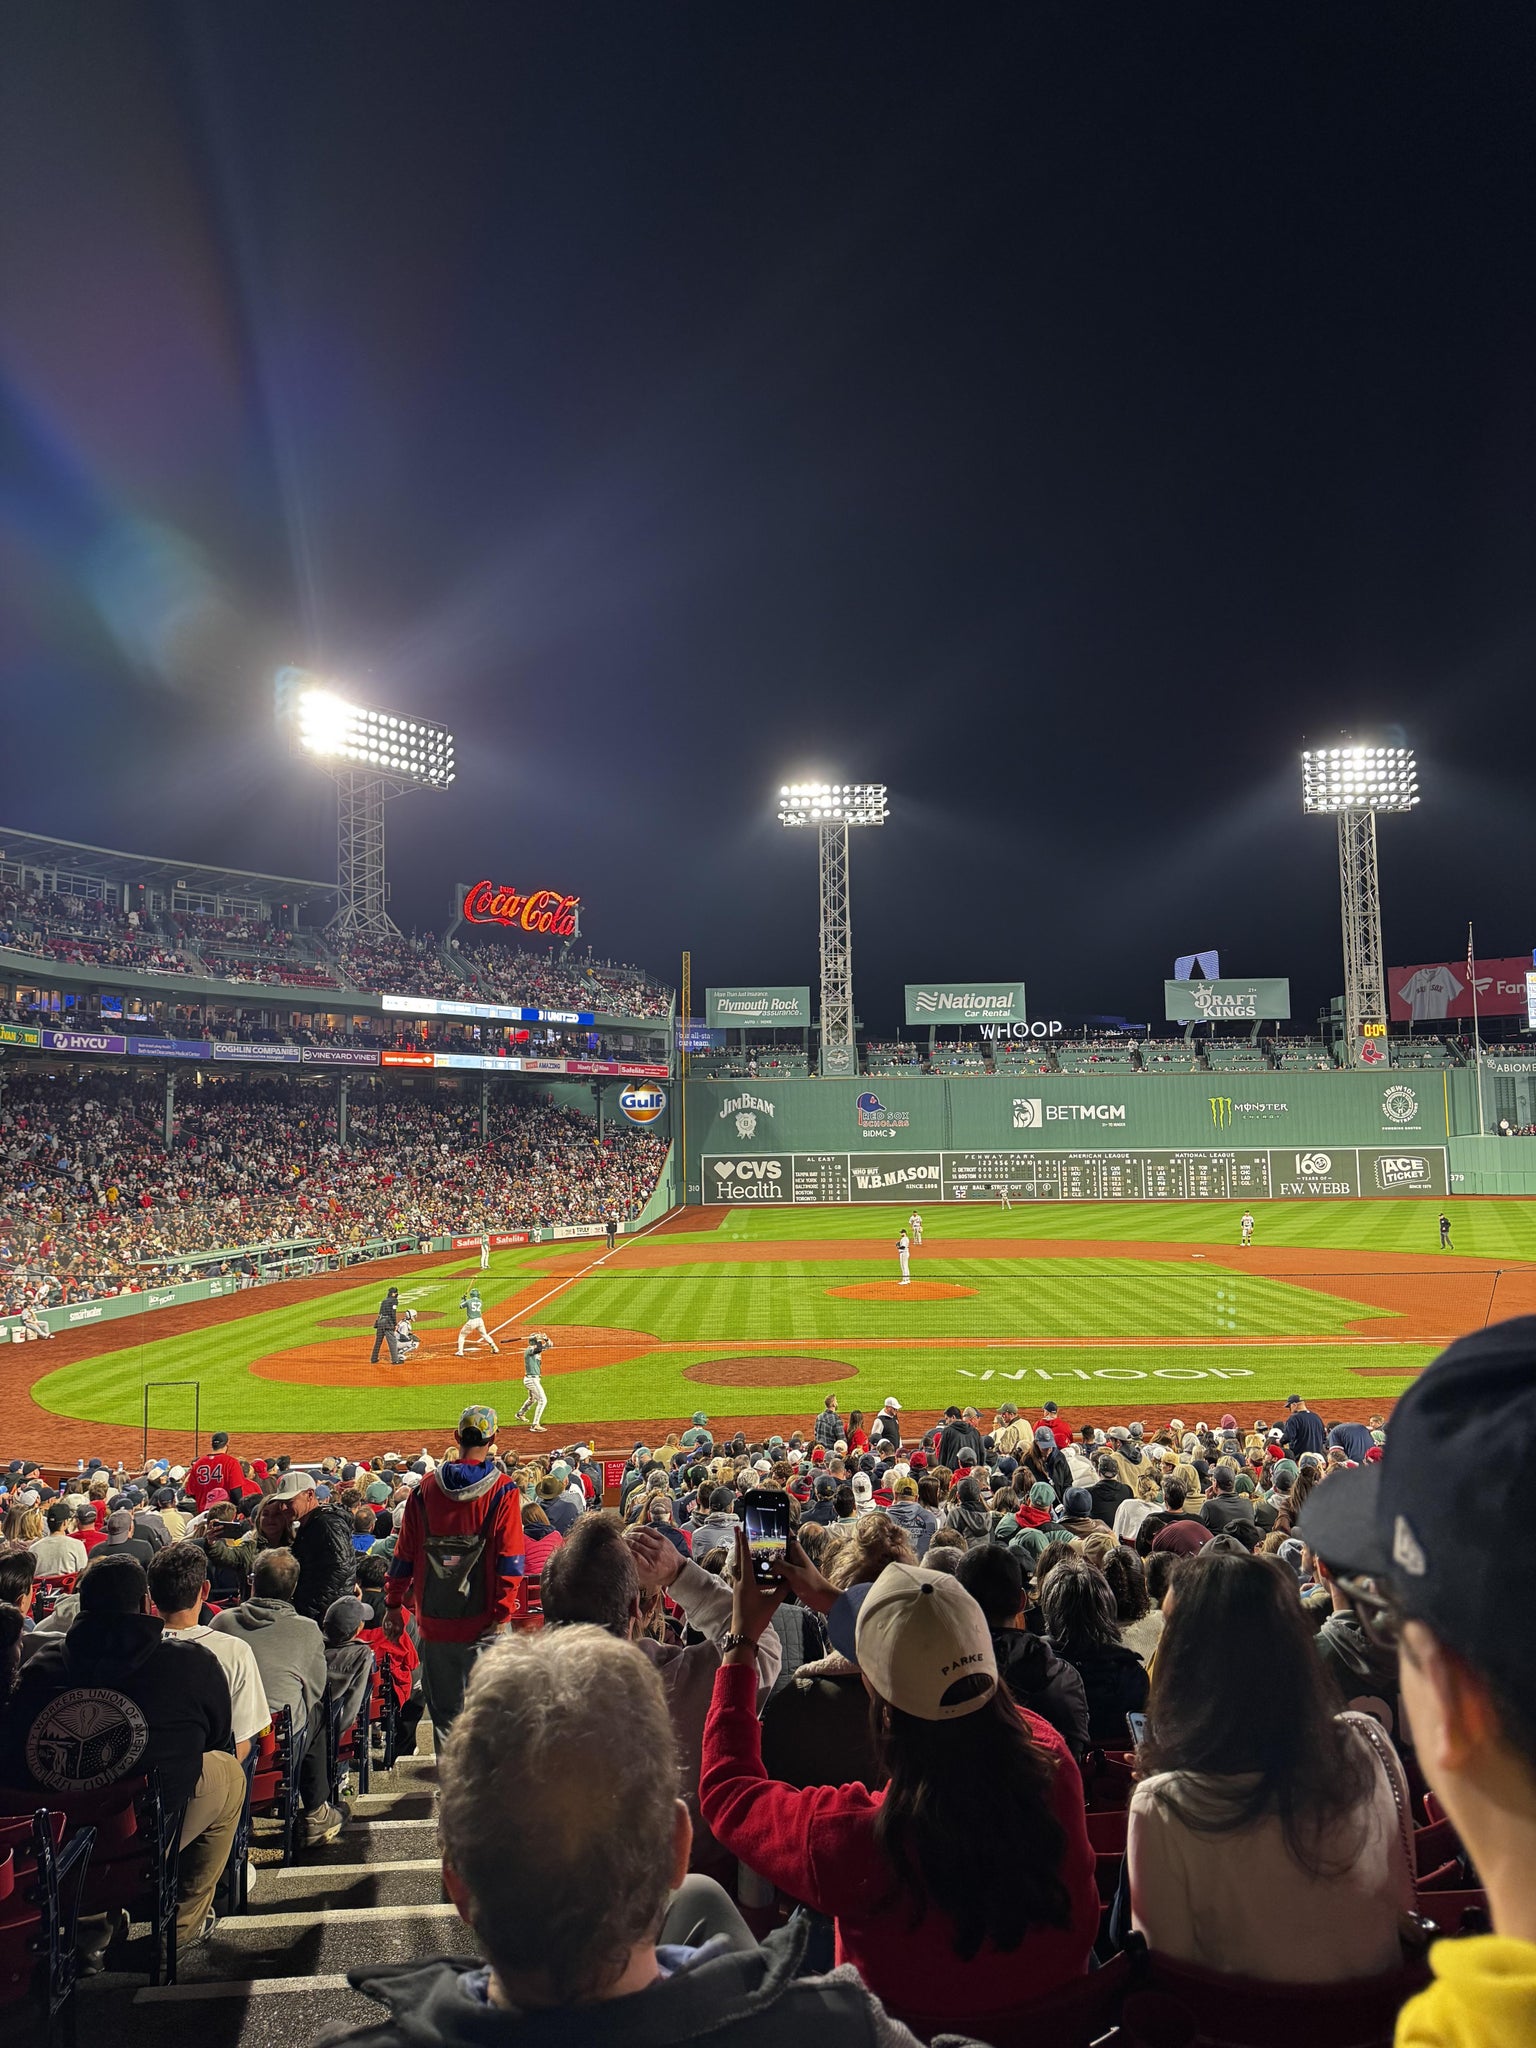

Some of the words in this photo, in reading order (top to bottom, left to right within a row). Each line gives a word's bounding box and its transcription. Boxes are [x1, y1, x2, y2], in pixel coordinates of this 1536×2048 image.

[464, 880, 580, 936] Coca-Cola
[717, 999, 768, 1012] Plymouth
[771, 998, 799, 1010] Rock
[938, 992, 1014, 1009] National
[1195, 994, 1257, 1009] DRAFT
[965, 1010, 979, 1018] Car
[982, 1009, 1010, 1017] Rental
[1203, 1005, 1256, 1017] KINGS
[980, 1021, 1063, 1040] WHOOP
[25, 1033, 38, 1043] TIRE
[71, 1037, 108, 1049] HYCU
[216, 1045, 251, 1054] COGHLIN
[252, 1046, 299, 1056] COMPANIES
[312, 1051, 352, 1060] VINEYARD
[354, 1053, 377, 1061] VINES
[622, 1066, 644, 1074] Safelite
[1383, 1085, 1403, 1098] IBEW
[622, 1094, 664, 1108] Gulf
[719, 1098, 741, 1118] JIM
[742, 1093, 775, 1118] BEAM
[1234, 1102, 1288, 1112] MONSTER
[862, 1112, 884, 1120] RED
[888, 1112, 909, 1120] SOX
[1046, 1105, 1126, 1120] BETMGM
[736, 1161, 782, 1180] CVS
[1385, 1158, 1424, 1173] ACE
[1387, 1171, 1424, 1182] TICKET
[688, 1184, 699, 1192] 310
[716, 1181, 783, 1199] Health
[955, 1190, 966, 1198] 52
[1280, 1183, 1305, 1195] F.W.
[1313, 1182, 1350, 1194] WEBB
[496, 1235, 525, 1244] Safelite
[69, 1307, 103, 1321] smartwater
[471, 1302, 482, 1312] 52
[956, 1368, 1255, 1380] WHOOP
[197, 1464, 224, 1485] 34
[941, 1653, 984, 1676] PARKE
[89, 1690, 128, 1708] UNION
[34, 1690, 84, 1731] WORKERS
[126, 1706, 139, 1720] OF
[118, 1722, 147, 1772] AMERICA
